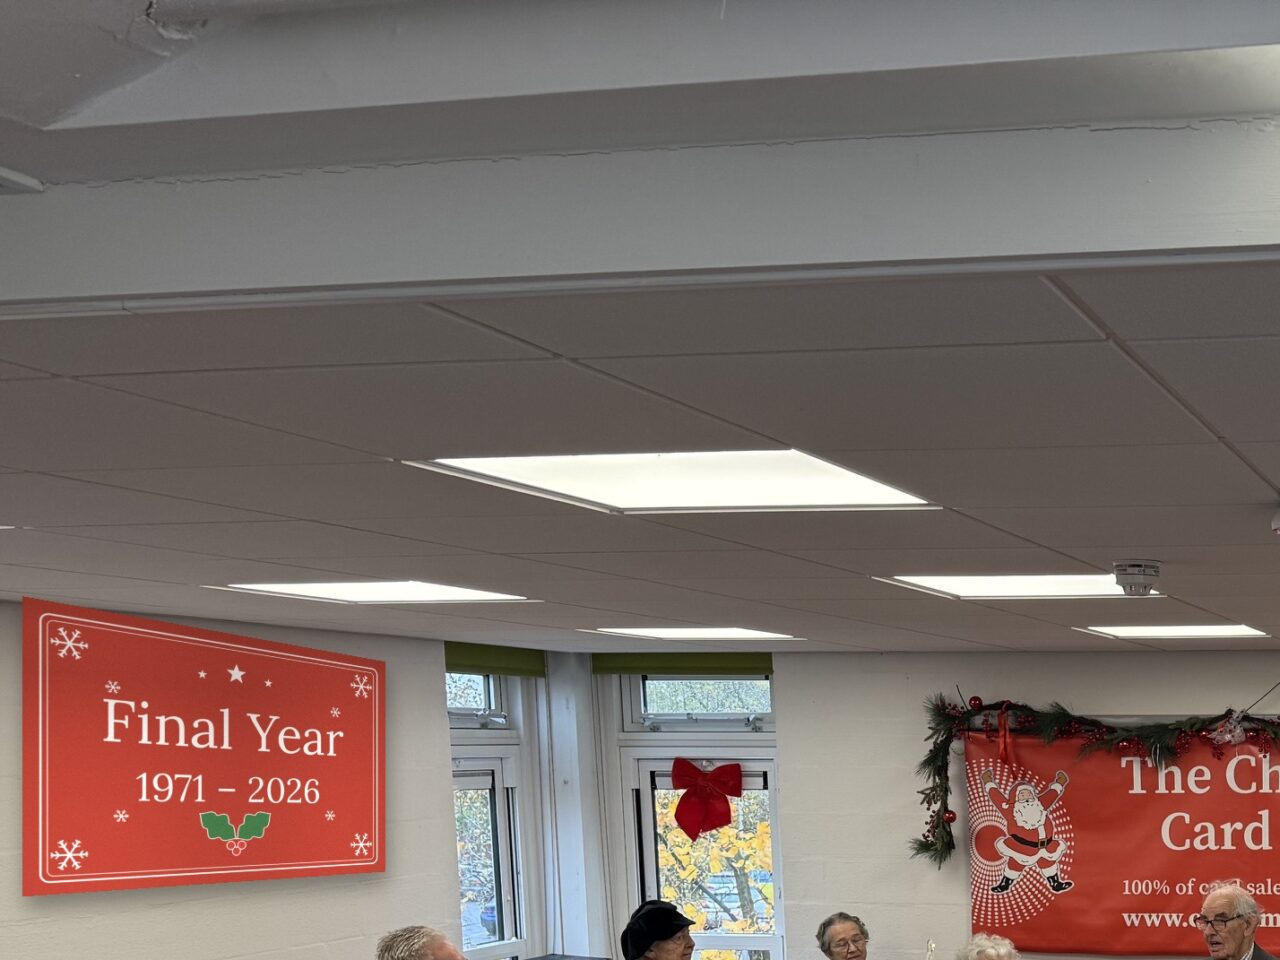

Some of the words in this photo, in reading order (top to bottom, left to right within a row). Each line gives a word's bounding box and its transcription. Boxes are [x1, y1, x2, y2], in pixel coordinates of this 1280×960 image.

[103, 698, 232, 750] Final
[246, 712, 344, 756] Year
[135, 772, 206, 802] 1971
[247, 776, 320, 804] 2026
[1121, 756, 1211, 794] The
[1161, 809, 1272, 851] Card
[1122, 879, 1170, 896] 100%
[1175, 878, 1196, 895] of
